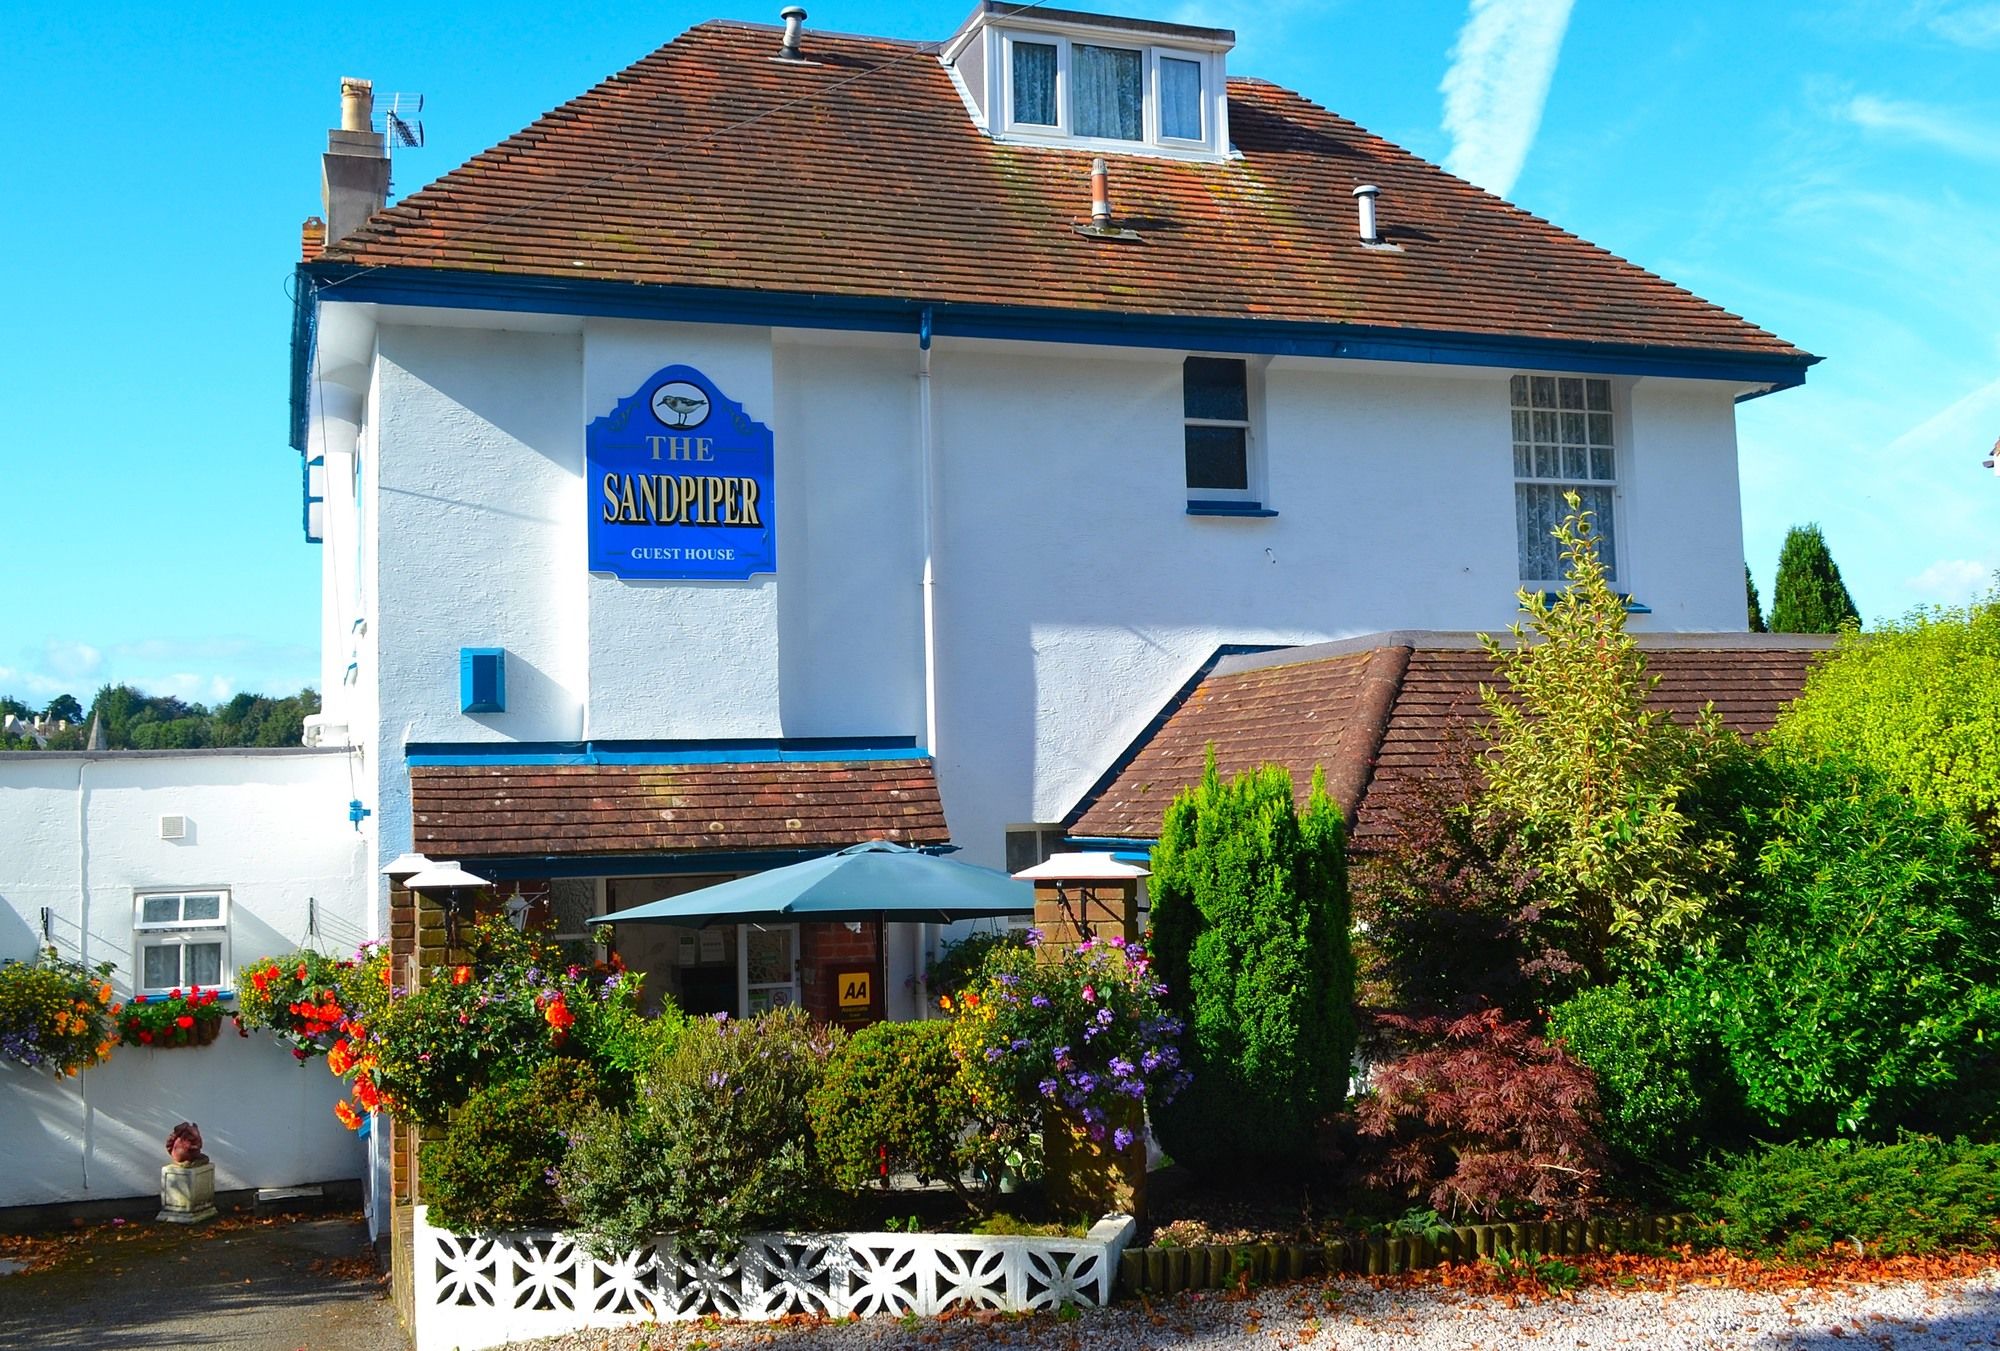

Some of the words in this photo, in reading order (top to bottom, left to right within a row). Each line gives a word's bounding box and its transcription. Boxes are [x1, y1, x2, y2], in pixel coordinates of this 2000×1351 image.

[645, 435, 714, 462] THE
[603, 472, 760, 526] SANDPIPER
[631, 547, 681, 560] GUEST
[684, 548, 735, 561] HOUSE
[844, 982, 866, 999] AA
